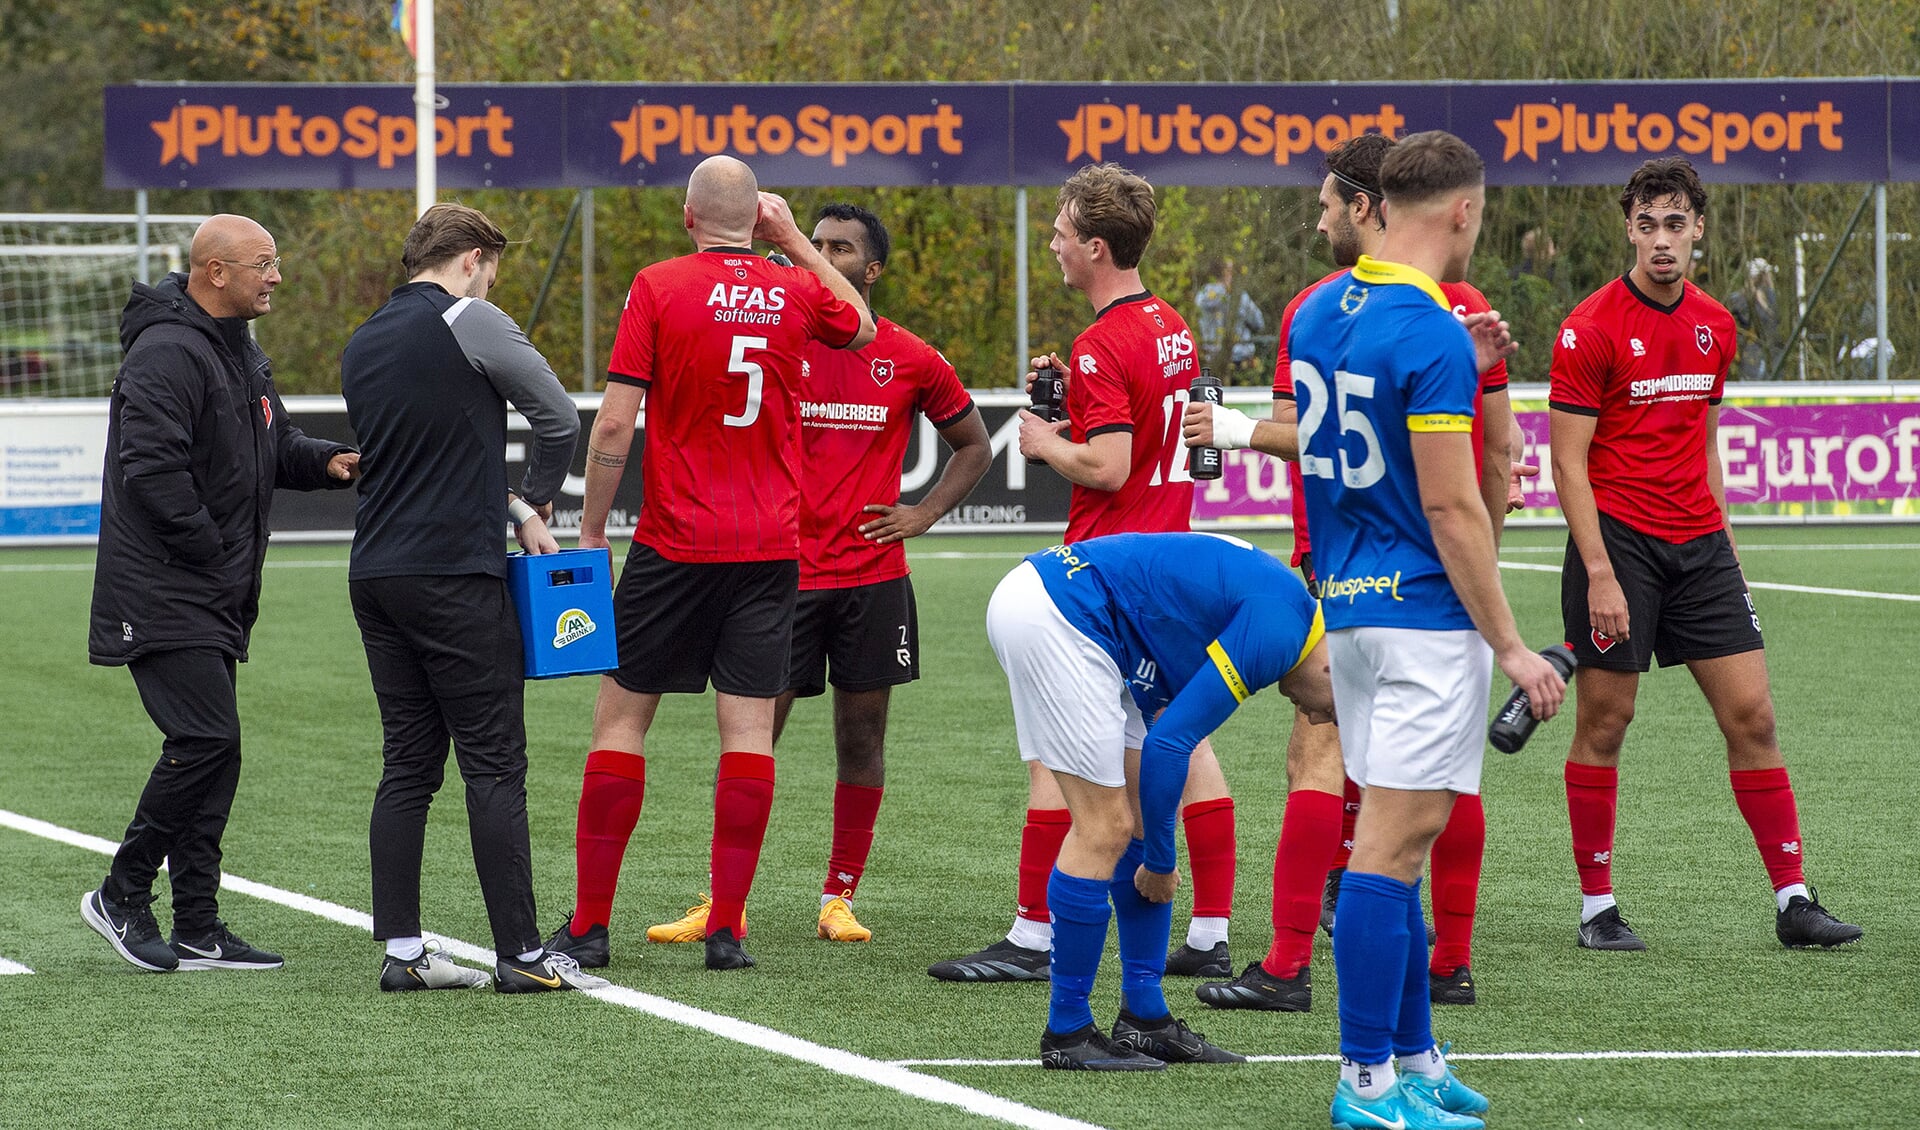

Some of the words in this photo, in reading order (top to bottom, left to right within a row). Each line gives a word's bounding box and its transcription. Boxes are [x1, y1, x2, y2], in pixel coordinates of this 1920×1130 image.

[180, 105, 514, 168] PlutoSport
[640, 104, 963, 167] PlutoSport
[1085, 103, 1405, 166] PlutoSport
[1522, 101, 1843, 163] PlutoSport
[706, 282, 785, 312] AFAS
[714, 308, 781, 326] software
[1156, 329, 1194, 365] AFAS
[723, 335, 768, 428] 5
[1288, 359, 1387, 489] 25
[1717, 416, 1920, 489] Eurof
[565, 626, 590, 643] DRINK
[568, 617, 585, 634] AA
[898, 624, 908, 646] 2
